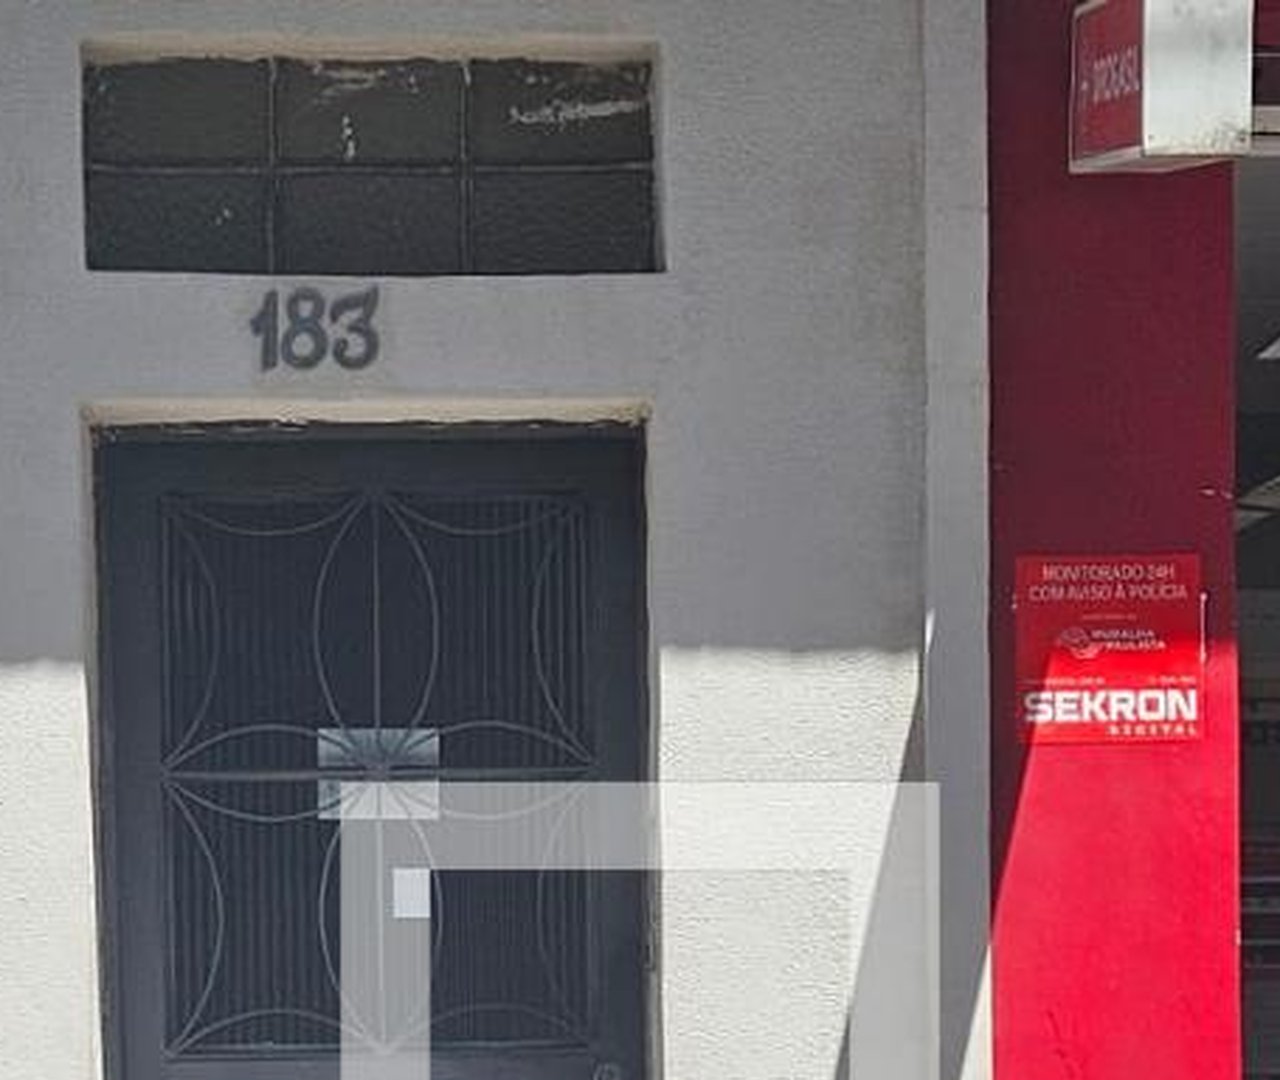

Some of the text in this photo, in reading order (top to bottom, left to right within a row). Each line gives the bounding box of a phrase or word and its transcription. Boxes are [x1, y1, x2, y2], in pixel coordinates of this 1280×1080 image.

[250, 284, 379, 372] 183
[1042, 564, 1144, 582] MONITORADO
[1024, 688, 1197, 723] SEKRON
[1109, 724, 1197, 736] DIGITAL
